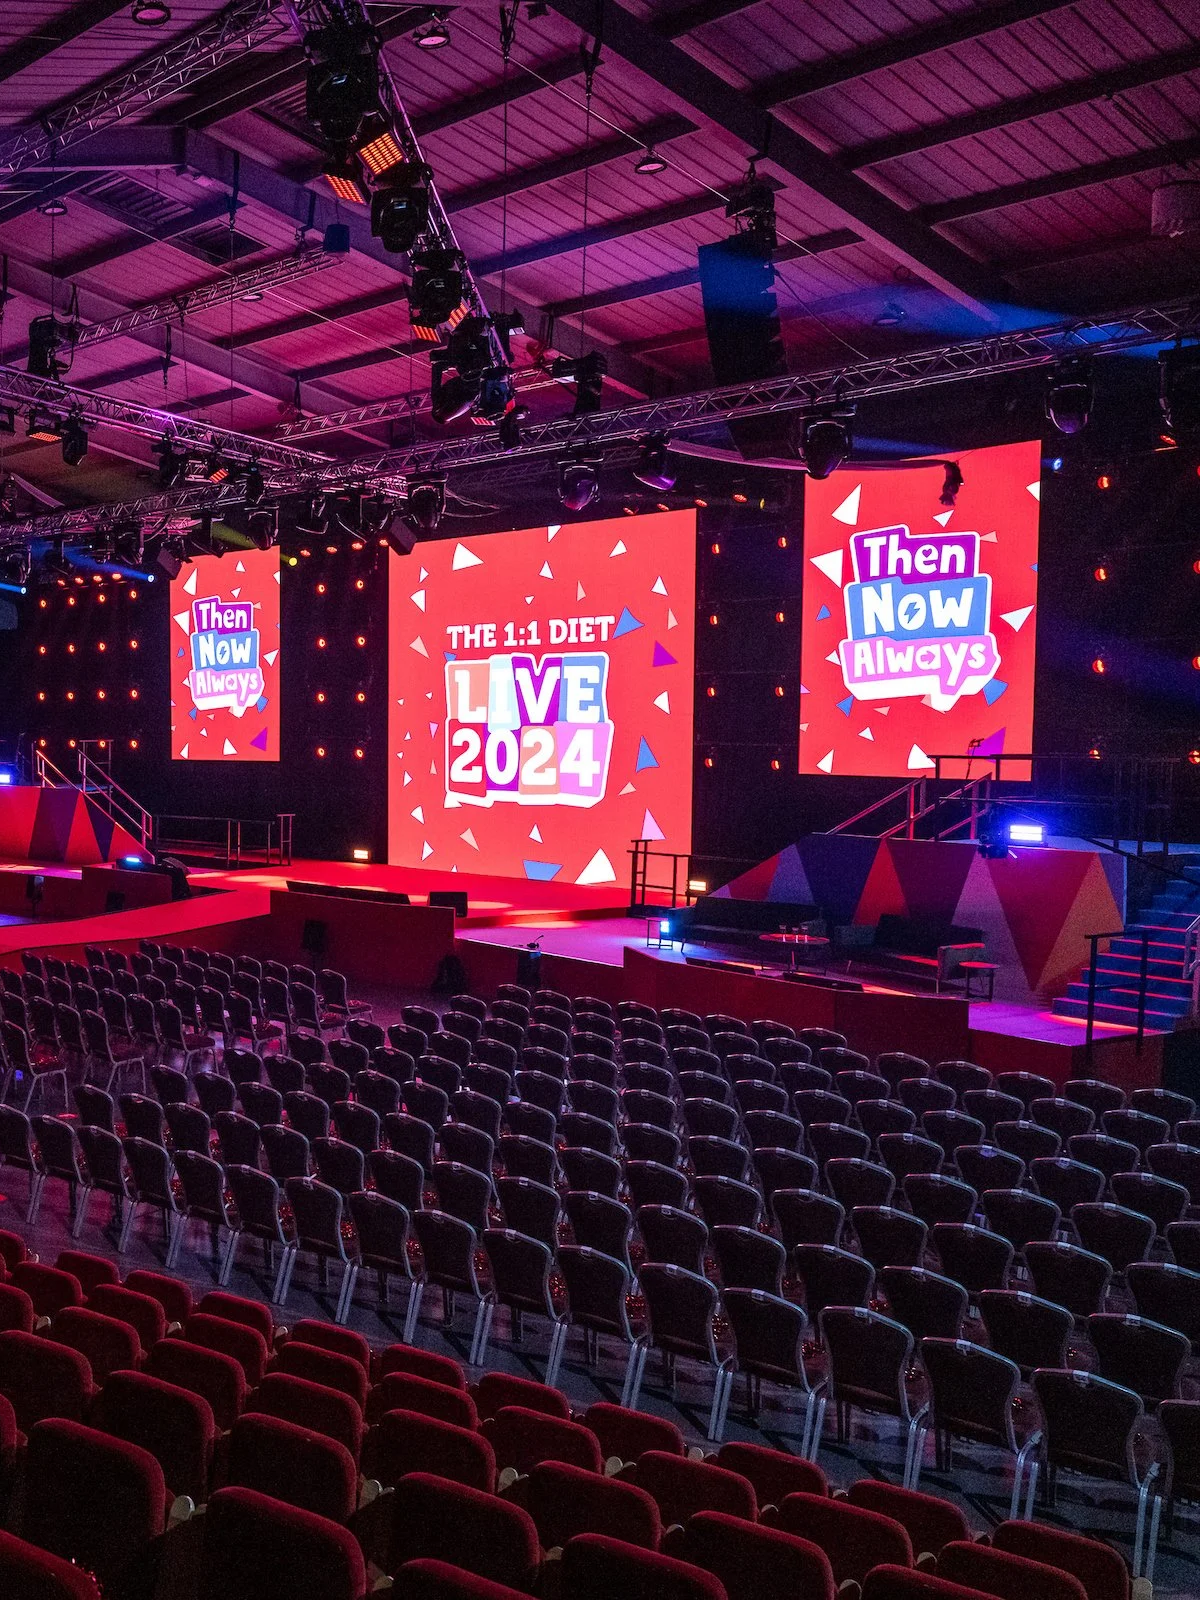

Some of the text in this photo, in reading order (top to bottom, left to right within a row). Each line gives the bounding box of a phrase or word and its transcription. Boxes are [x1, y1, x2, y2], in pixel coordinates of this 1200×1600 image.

[864, 532, 966, 577] Then
[199, 602, 248, 629] Then
[446, 616, 615, 650] THE 1:1 DIET
[854, 641, 986, 686] Always
[196, 672, 258, 702] Always
[455, 664, 601, 724] LIVE
[450, 727, 600, 788] 2024
